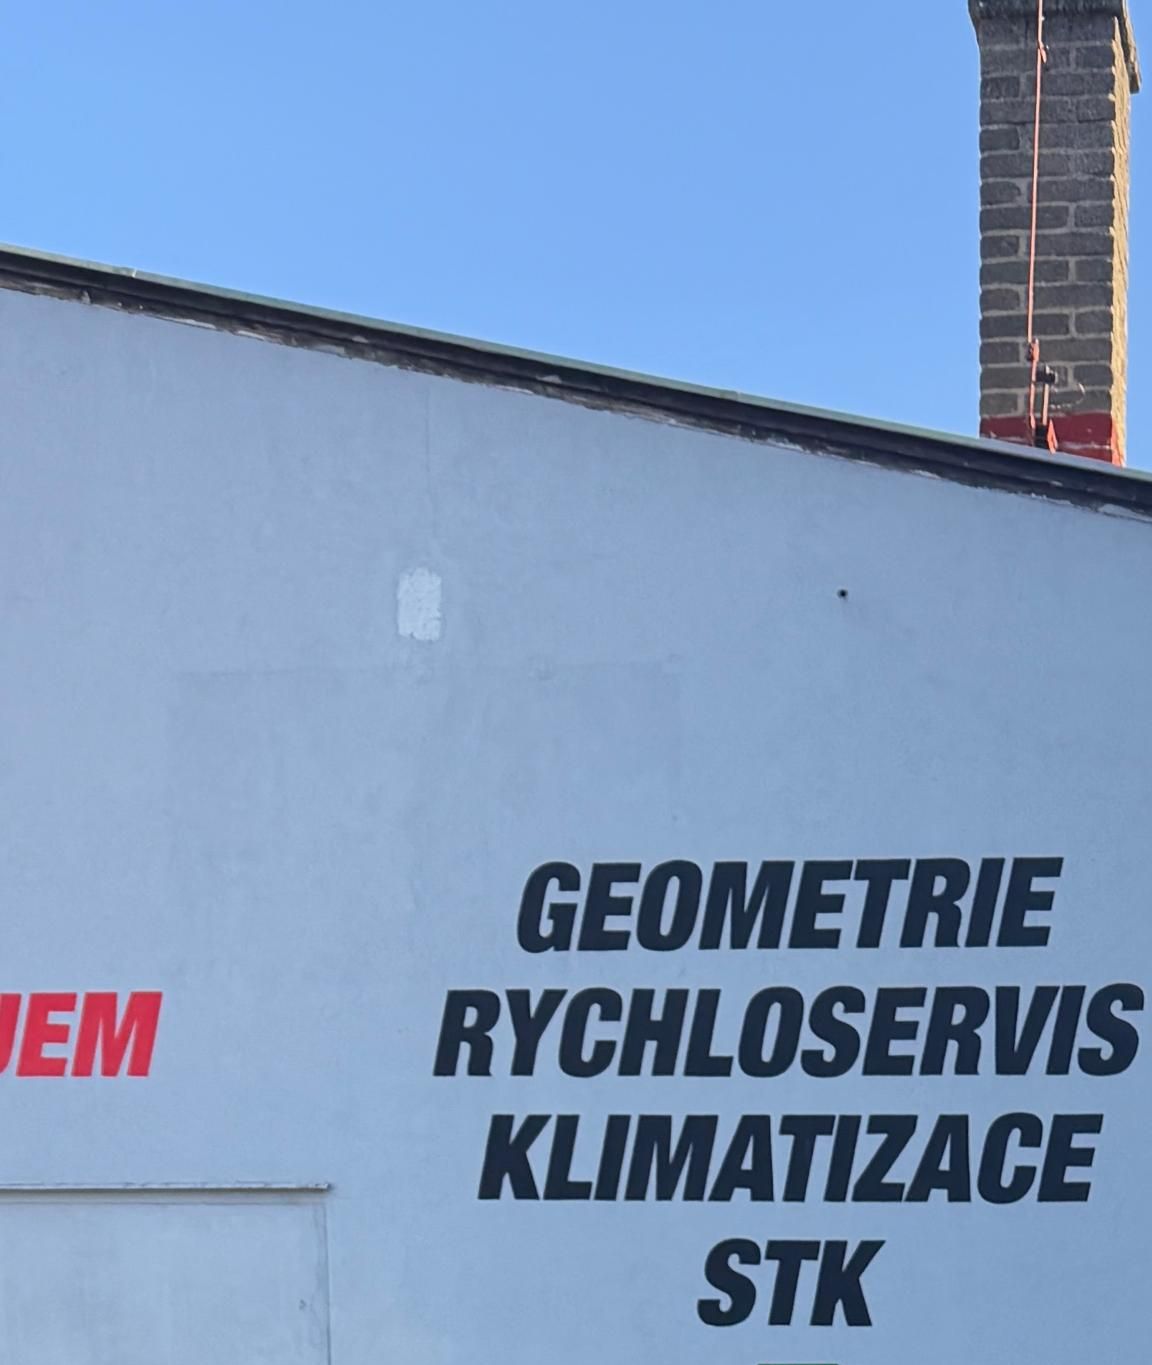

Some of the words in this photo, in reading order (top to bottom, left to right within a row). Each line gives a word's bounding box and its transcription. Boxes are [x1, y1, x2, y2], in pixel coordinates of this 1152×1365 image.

[518, 857, 1063, 953] GEOMETRIE
[434, 984, 1144, 1077] RYCHLOSERVIS
[478, 1113, 1103, 1204] KLIMATIZACE
[698, 1239, 885, 1326] STK
